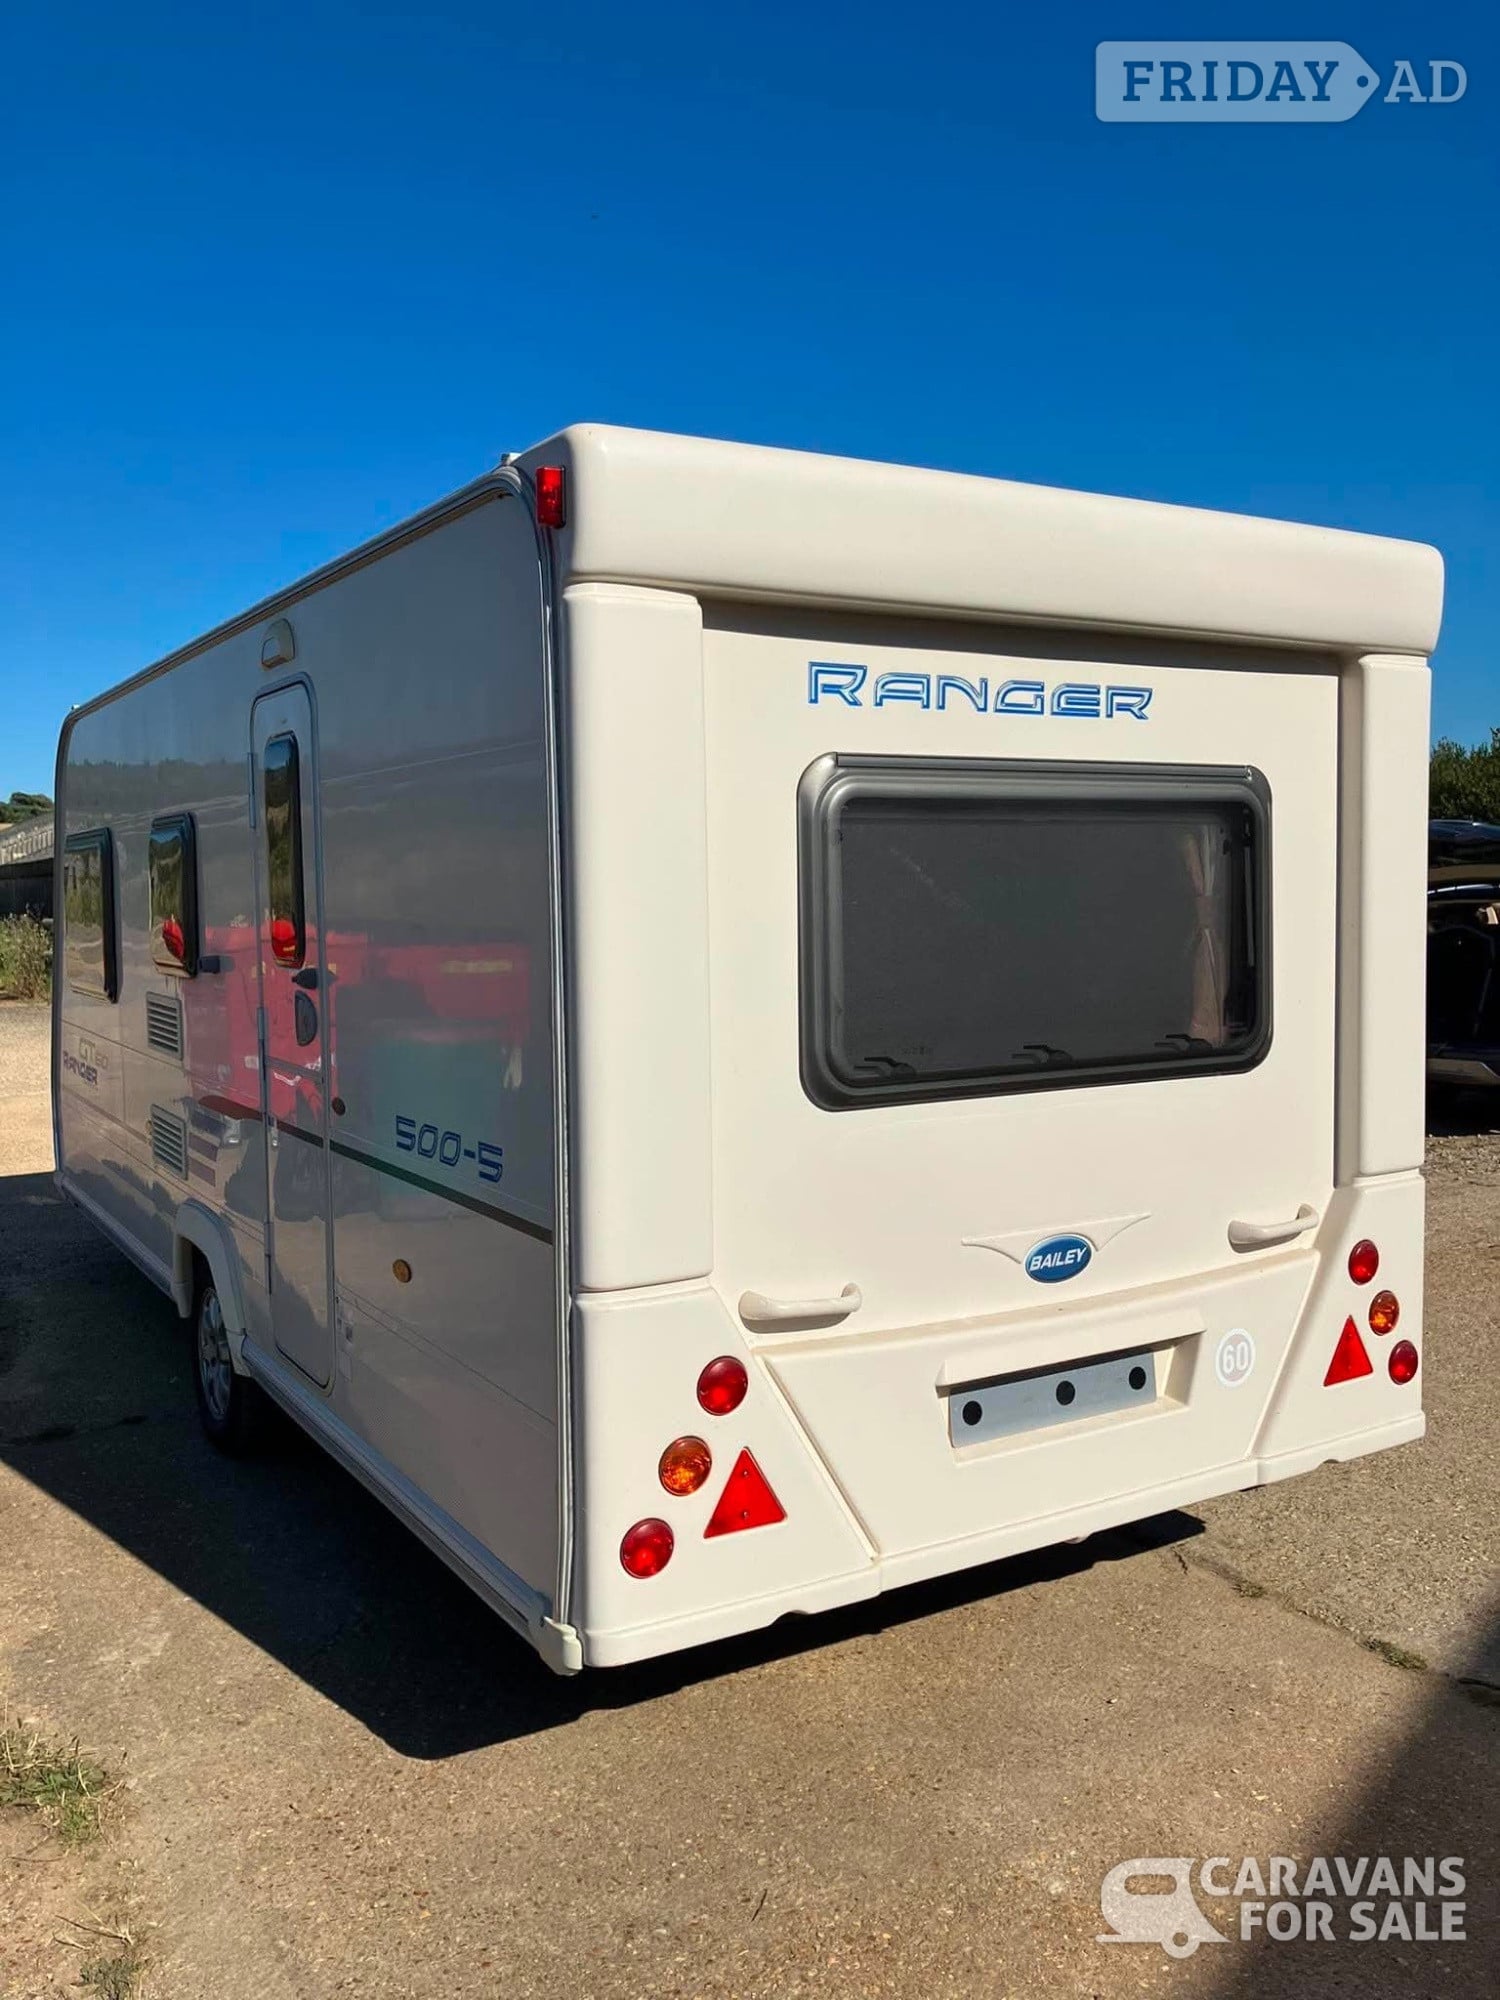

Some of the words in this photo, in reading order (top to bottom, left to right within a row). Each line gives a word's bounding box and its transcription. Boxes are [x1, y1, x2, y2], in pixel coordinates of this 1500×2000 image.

[808, 661, 1153, 720] RANGER
[63, 1050, 98, 1086] RANGER
[395, 1115, 503, 1184] 500-5
[1029, 1246, 1088, 1271] BAILEY
[1222, 1342, 1249, 1374] 60
